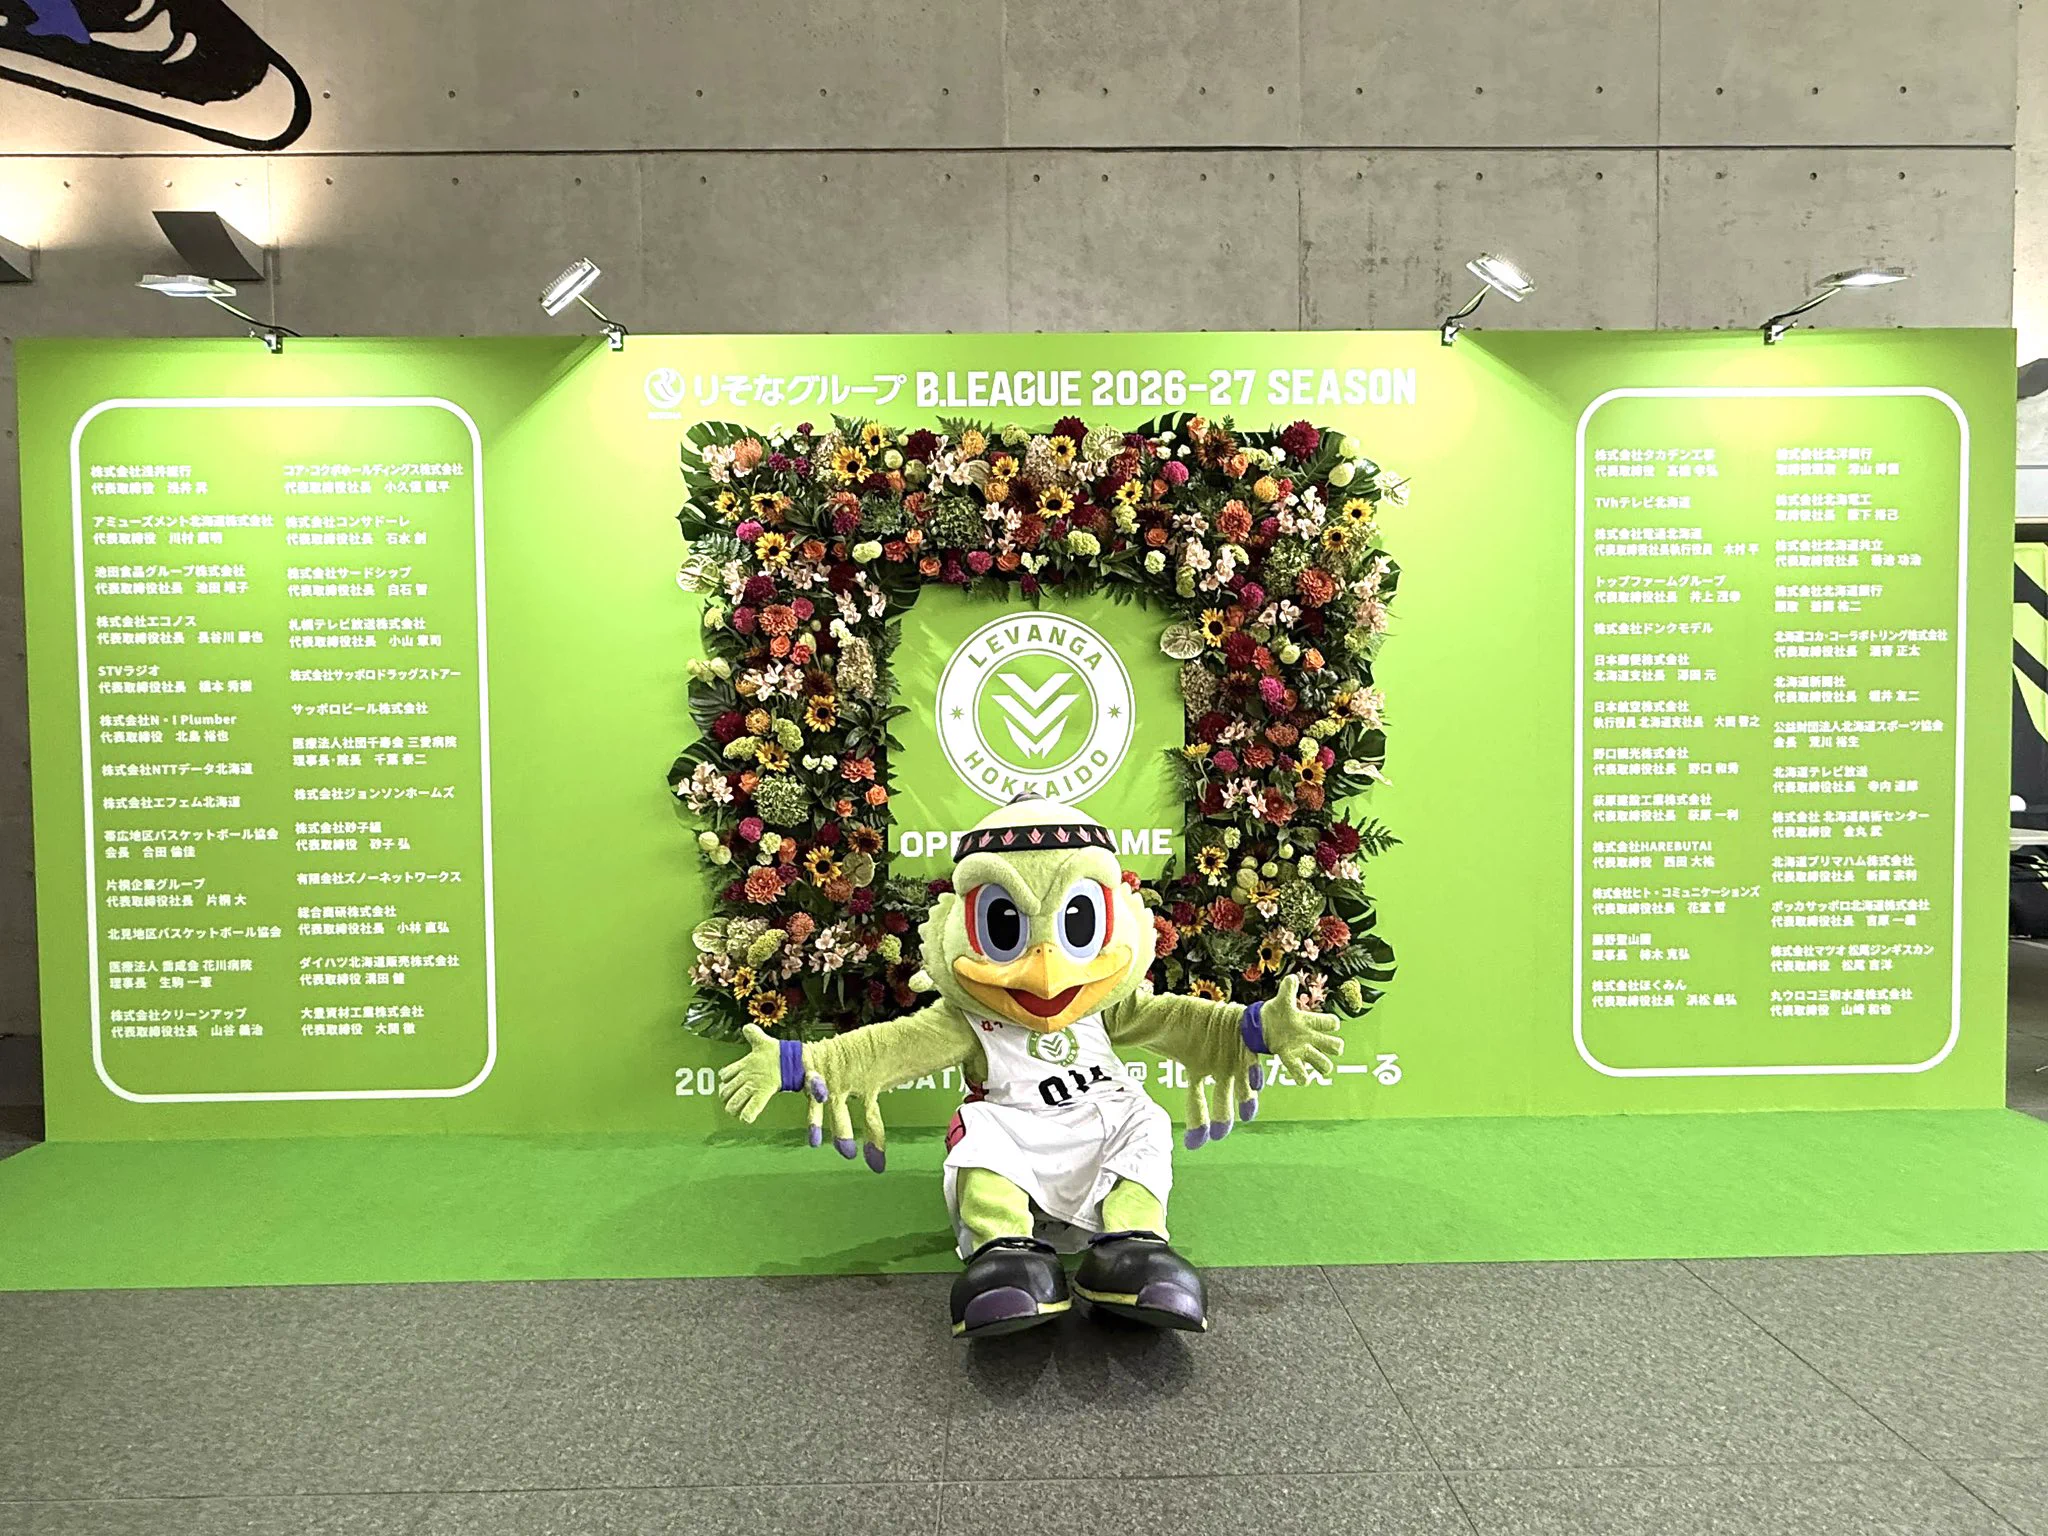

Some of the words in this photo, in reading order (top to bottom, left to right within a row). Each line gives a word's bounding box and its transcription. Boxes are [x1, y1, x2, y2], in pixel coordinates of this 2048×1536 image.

[694, 372, 909, 406] りそなグループ
[916, 370, 1082, 407] B.LEAGUE
[1091, 369, 1257, 406] 2026-27
[1267, 368, 1416, 405] SEASON
[92, 482, 154, 494] 代表取締役
[1595, 496, 1690, 508] TVhテレビ北海道
[286, 516, 409, 528] 株式会社コンサドーレ
[94, 532, 156, 544] 代表取締役
[286, 533, 373, 545] 代表取締役社長
[96, 564, 245, 579] 池田食品グループ株式会社
[288, 567, 411, 579] 株式会社サードシップ
[1597, 576, 1726, 587] トップファームグループ
[95, 582, 182, 594] 代表取締役社長
[196, 582, 220, 594] 池田
[288, 584, 374, 596] 代表取締役社長
[388, 584, 412, 596] 白石
[1594, 591, 1677, 603] 代表取締役社長
[1690, 591, 1713, 602] 井上
[97, 615, 196, 628] 株式会社エコノス
[289, 618, 425, 631] 札幌テレビ放送株式会社
[97, 632, 184, 644] 代表取締役社長
[198, 632, 234, 643] 長谷川
[290, 635, 376, 648] 代表取締役社長
[390, 635, 413, 647] 小山
[1775, 629, 1947, 643] 北海道コカ・コーラボトリング株式会社
[968, 624, 1104, 671] LEVANGA
[1775, 644, 1857, 658] 代表取締役社長
[99, 665, 159, 676] STVラジオ
[290, 668, 460, 682] 株式会社サッポロドラッグストアー
[99, 681, 186, 693] 代表取締役社長
[1774, 676, 1845, 688] 北海道新聞社
[1774, 691, 1856, 704] 代表取締役社長
[292, 702, 427, 715] サッポロビール株式会社
[1595, 701, 1689, 713] 日本航空株式会社
[181, 715, 236, 724] Plumber
[1775, 720, 1943, 733] 公益財団法人北海道スポーツ協会
[101, 731, 162, 743] 代表取締役
[408, 736, 456, 748] 三愛病院
[1774, 736, 1796, 748] 会長
[102, 763, 253, 776] 株式会社NTTデータ北海道
[963, 749, 1109, 798] HOKKAIDO
[1593, 763, 1676, 775] 代表取締役社長
[1689, 763, 1712, 774] 野口
[1774, 766, 1868, 778] 北海道テレビ放送
[294, 786, 454, 800] 株式会社ジョンソンホームズ
[1773, 781, 1855, 794] 代表取締役社長
[1593, 809, 1676, 822] 代表取締役社長
[1772, 812, 1821, 824] 株式会社
[105, 828, 278, 841] 帯広地区バスケットボール協会
[1772, 826, 1831, 838] 代表取締役
[296, 838, 357, 851] 代表取締役
[398, 838, 410, 849] 弘
[1593, 840, 1711, 853] 株式会社HAREBUTAI
[106, 847, 129, 858] 会長
[1593, 856, 1652, 868] 代表取締役
[1772, 870, 1854, 882] 代表取締役社長
[107, 878, 204, 891] 片桐企業グループ
[1593, 886, 1760, 899] 株式会社ヒト・コミュニケーションズ
[107, 894, 193, 907] 代表取締役社長
[207, 895, 231, 906] 片桐
[235, 894, 246, 905] 大
[298, 906, 396, 918] 総合商研株式会社
[1593, 902, 1675, 915] 代表取締役社長
[1771, 914, 1854, 927] 代表取締役社長
[108, 926, 281, 940] 北見地区バスケットボール協会
[298, 922, 384, 935] 代表取締役社長
[398, 922, 421, 933] 小林
[1593, 949, 1627, 960] 理事長
[1771, 945, 1846, 957] 株式会社マツオ
[1849, 944, 1934, 956] 松尾ジンギスカン
[110, 960, 158, 972] 医療法人
[203, 960, 252, 971] 花川病院
[300, 955, 459, 969] ダイハツ北海道販売株式会社
[1771, 960, 1829, 972] 代表取締役
[110, 978, 146, 989] 理事長
[160, 977, 183, 988] 生駒
[300, 972, 360, 985] 代表取締役
[1592, 980, 1686, 992] 株式会社ほくみん
[1592, 995, 1674, 1007] 代表取締役社長
[111, 1008, 246, 1022] 株式会社クリーンアップ
[1770, 1004, 1829, 1017] 代表取締役
[112, 1025, 197, 1038] 代表取締役社長
[212, 1025, 235, 1036] 山谷
[302, 1024, 362, 1036] 代表取締役
[1128, 1062, 1148, 1084] @
